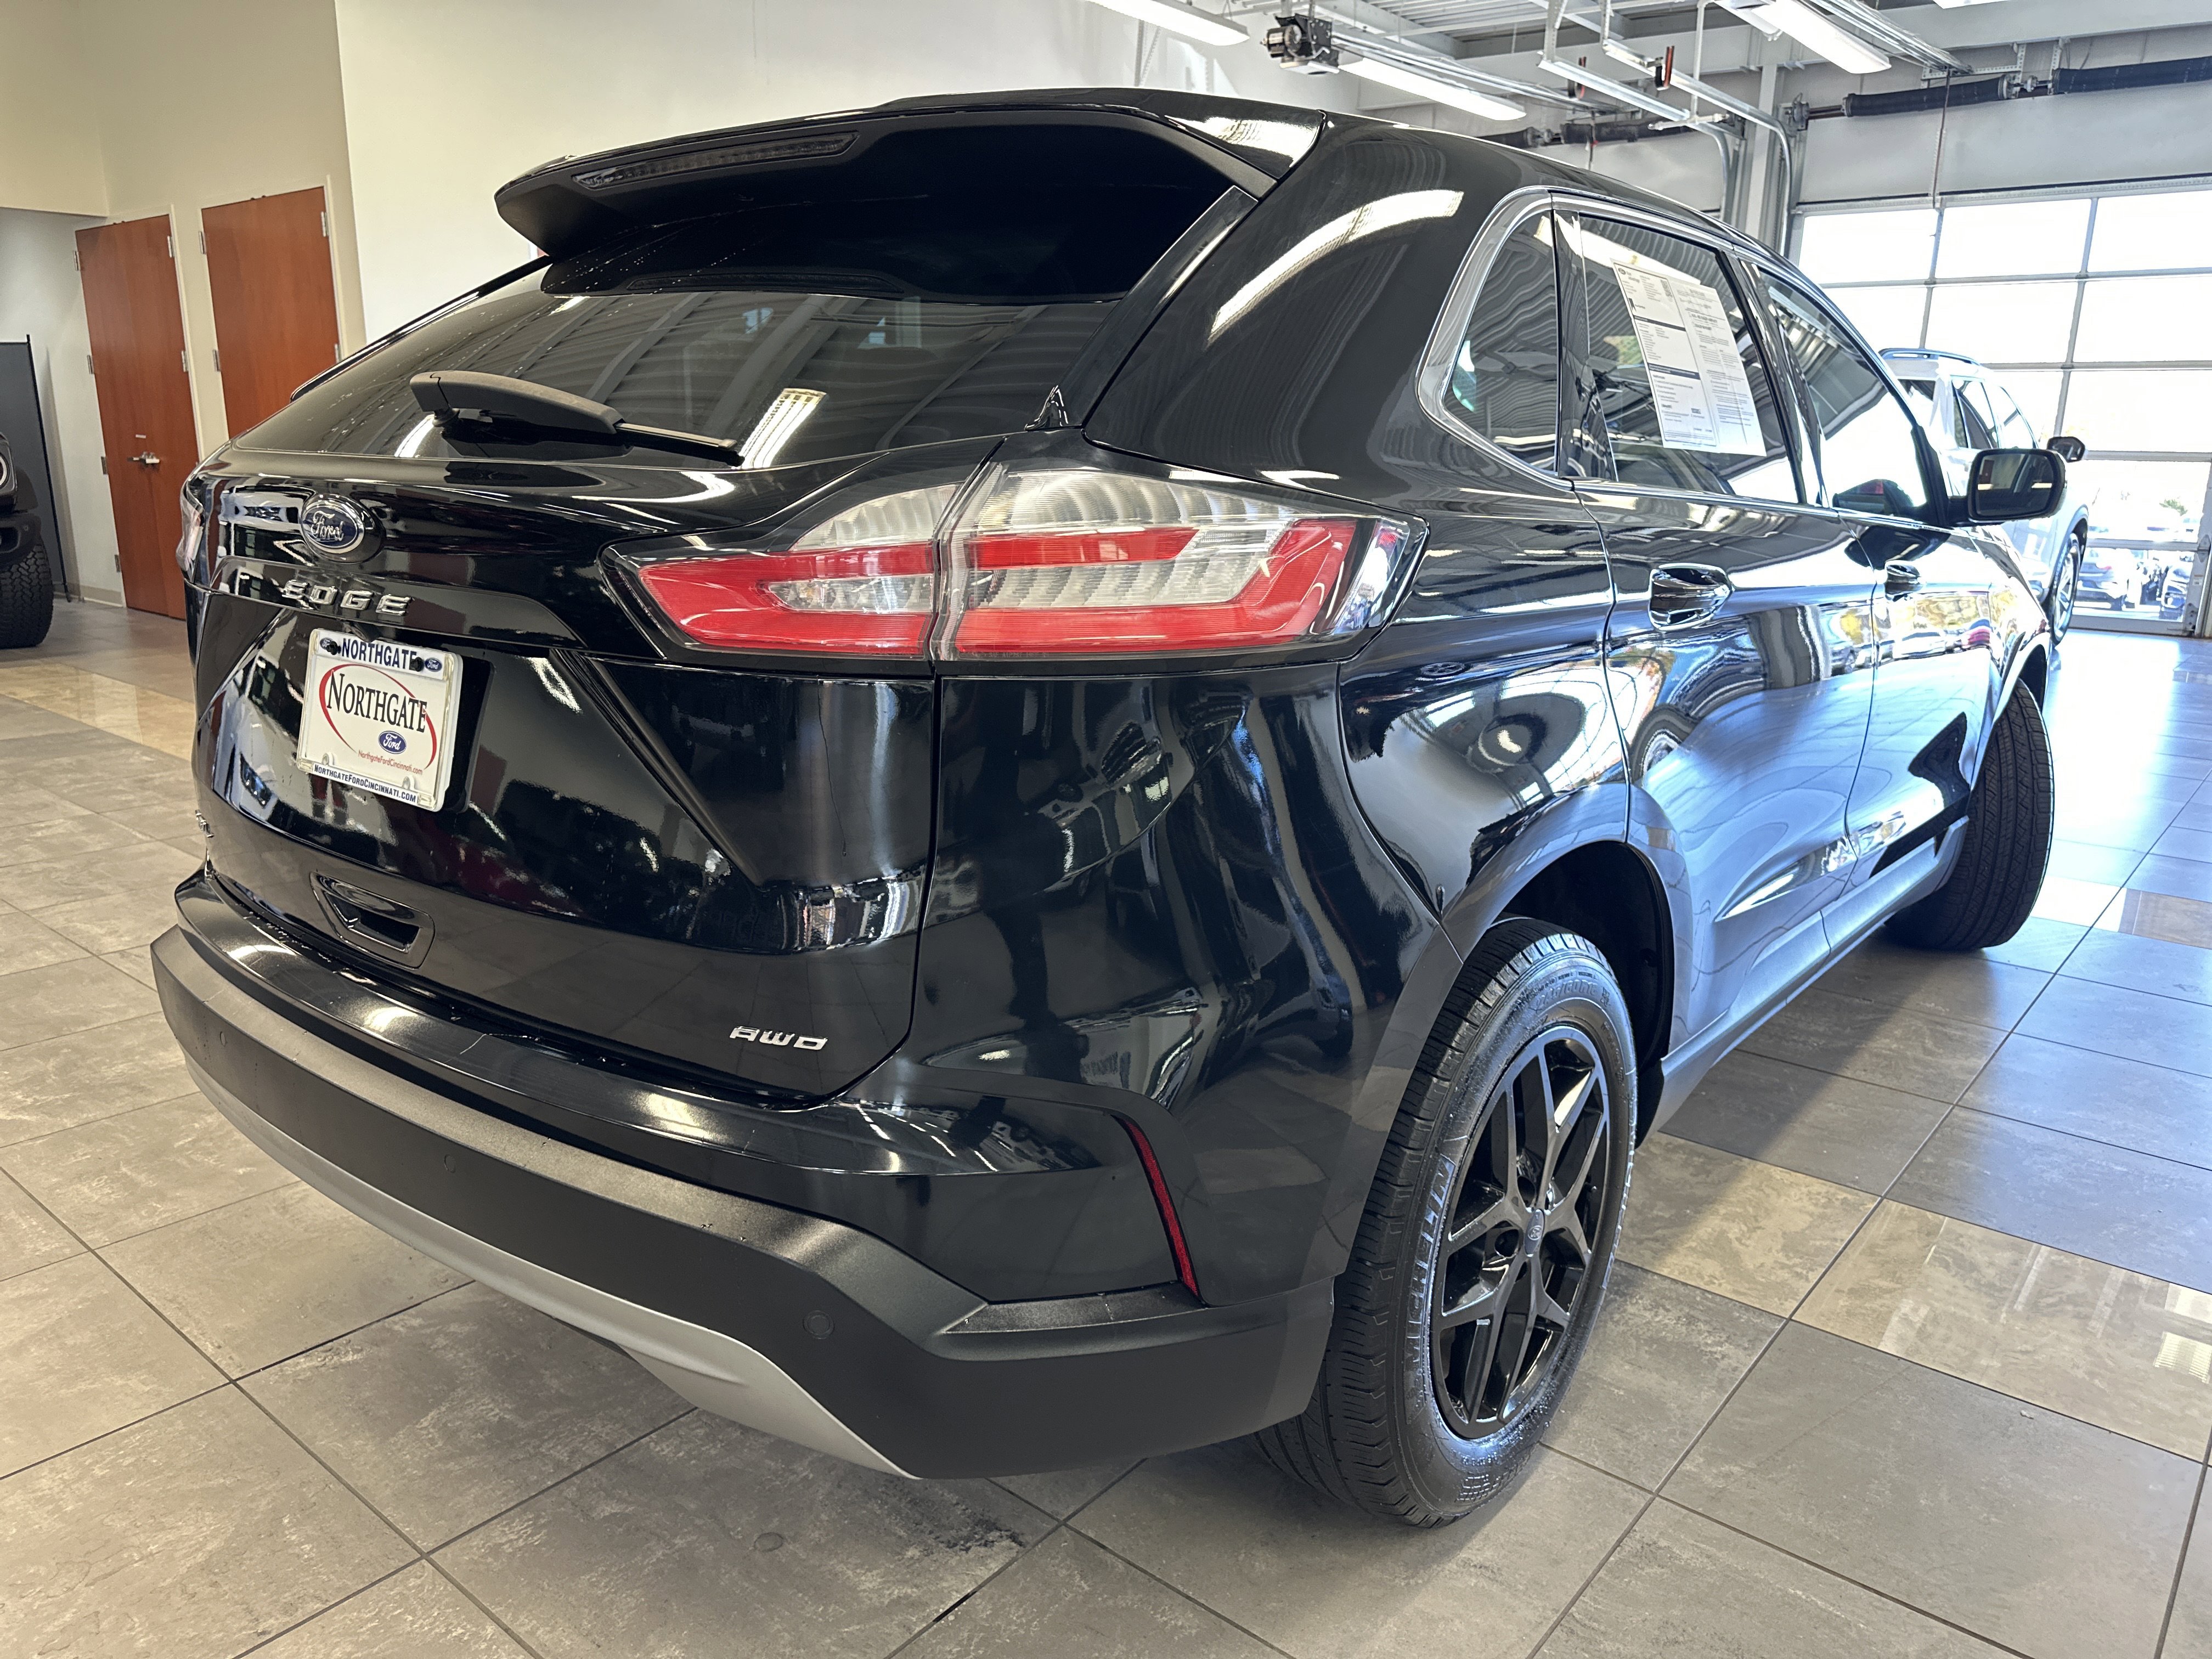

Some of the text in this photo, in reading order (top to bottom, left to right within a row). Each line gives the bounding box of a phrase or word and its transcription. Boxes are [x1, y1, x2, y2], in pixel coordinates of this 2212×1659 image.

[282, 579, 412, 617] EDGE
[358, 749, 423, 775] NorthgateFordCincinnati.com
[729, 1026, 828, 1051] AWD
